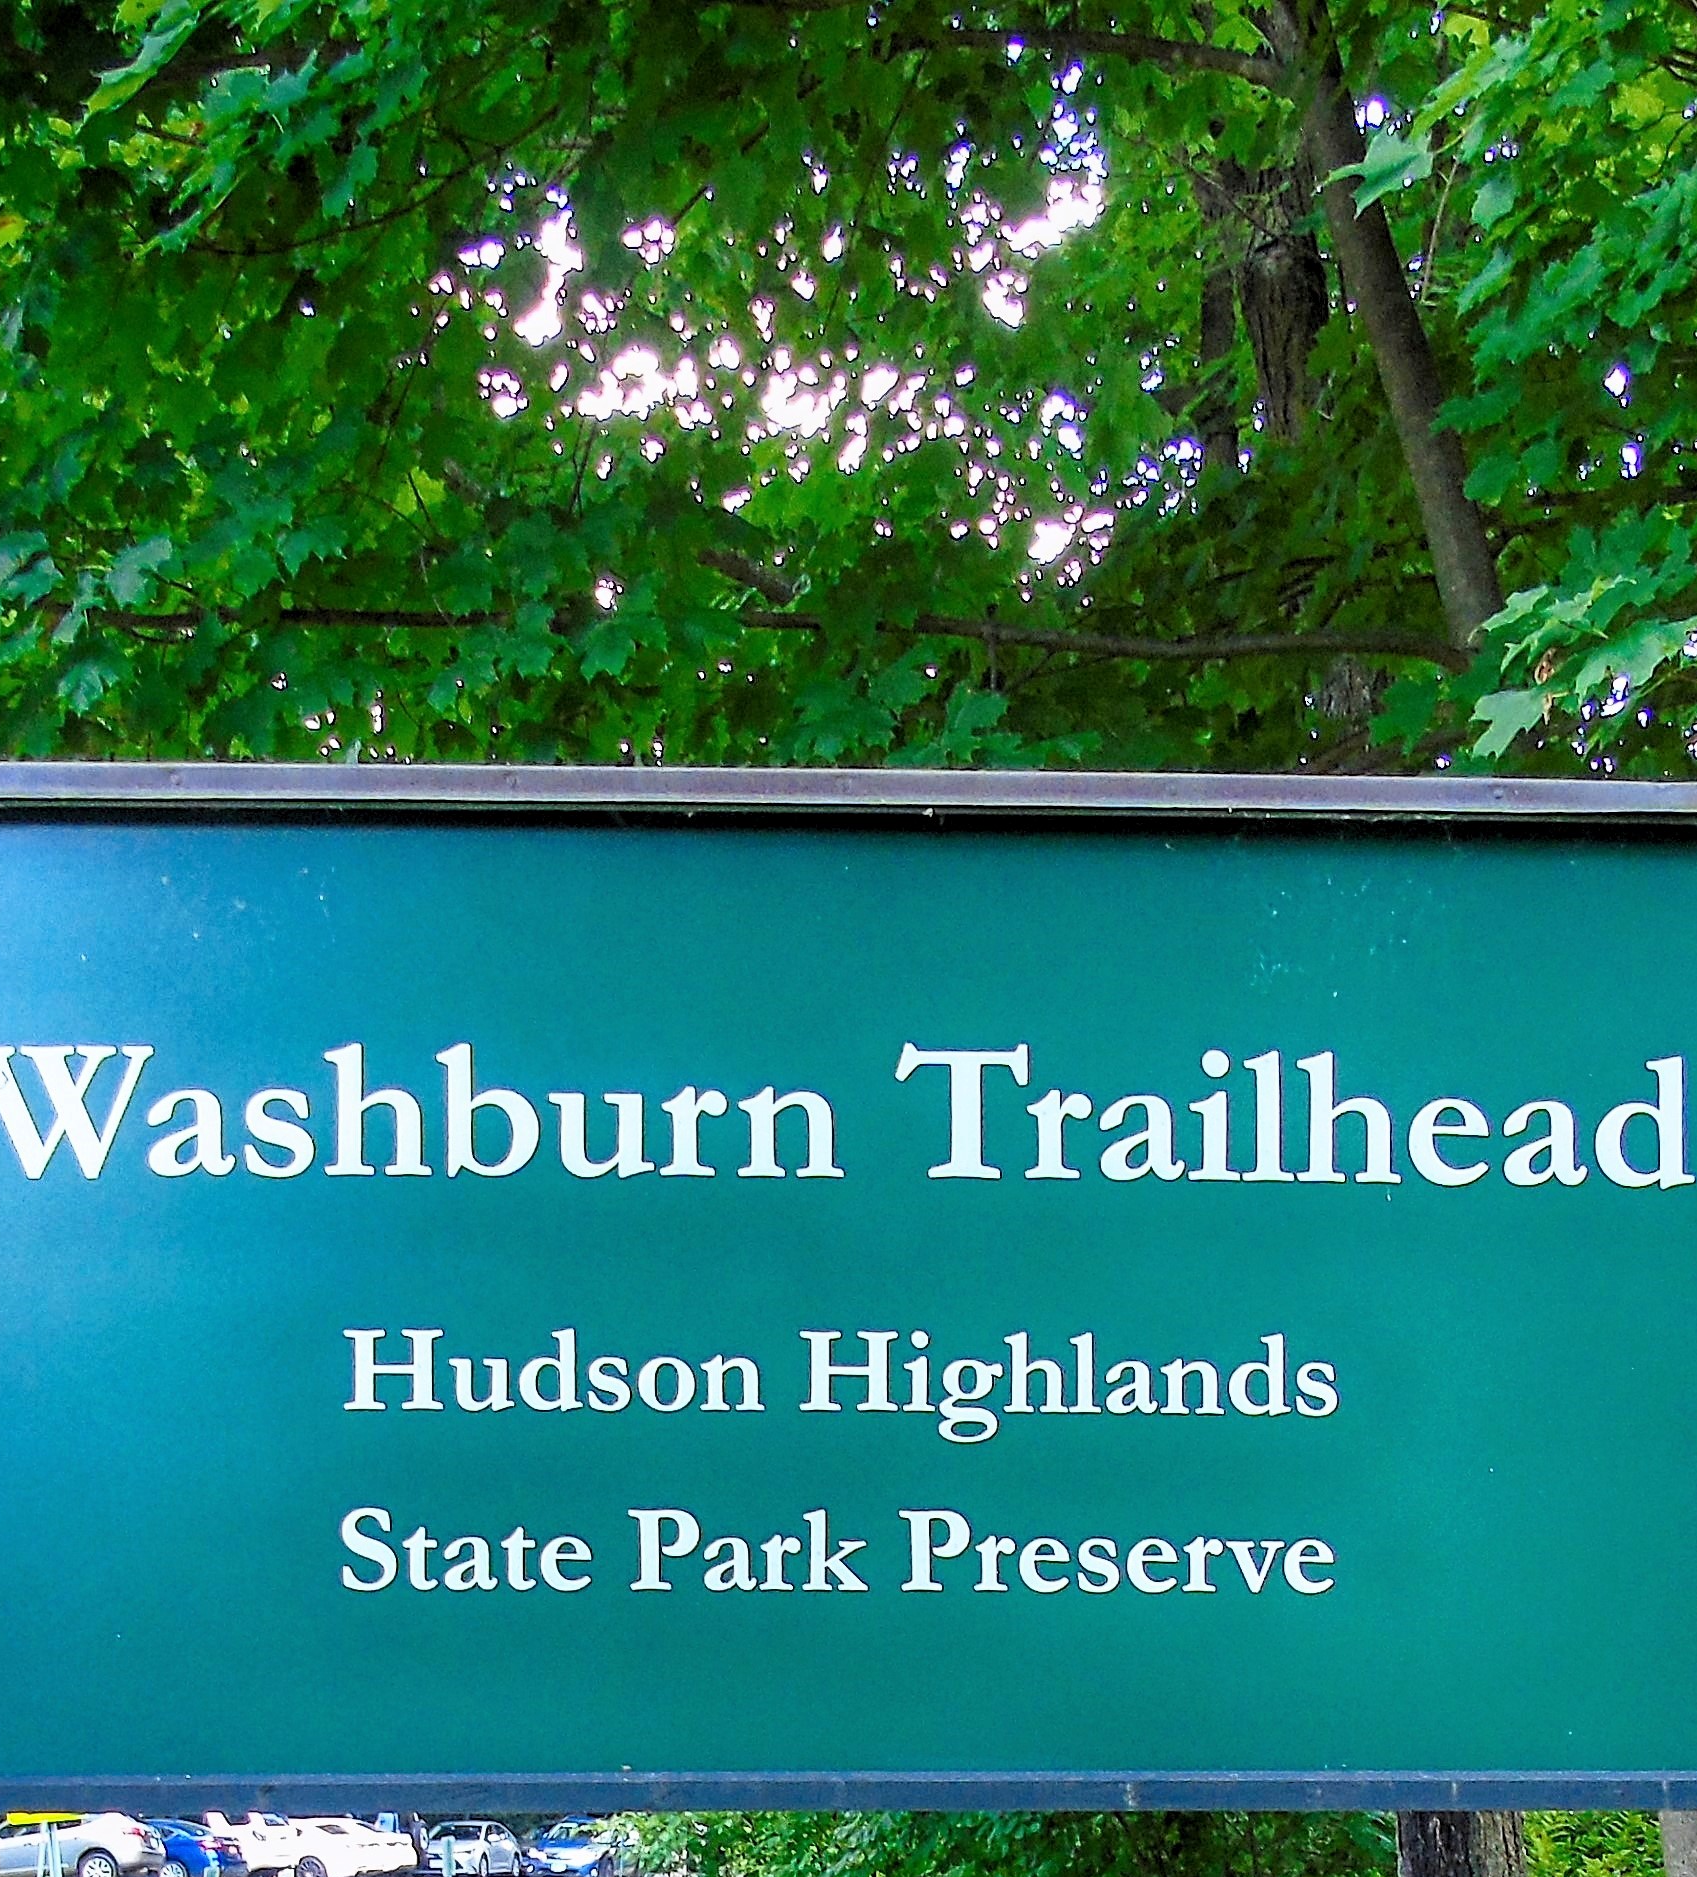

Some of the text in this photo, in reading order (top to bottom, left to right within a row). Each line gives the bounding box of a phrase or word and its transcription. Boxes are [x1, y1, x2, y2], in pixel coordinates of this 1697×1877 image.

[895, 1042, 1696, 1190] Trailhead
[342, 1328, 1338, 1443] Hudson Highlands
[340, 1507, 1334, 1594] State Park Preserve
